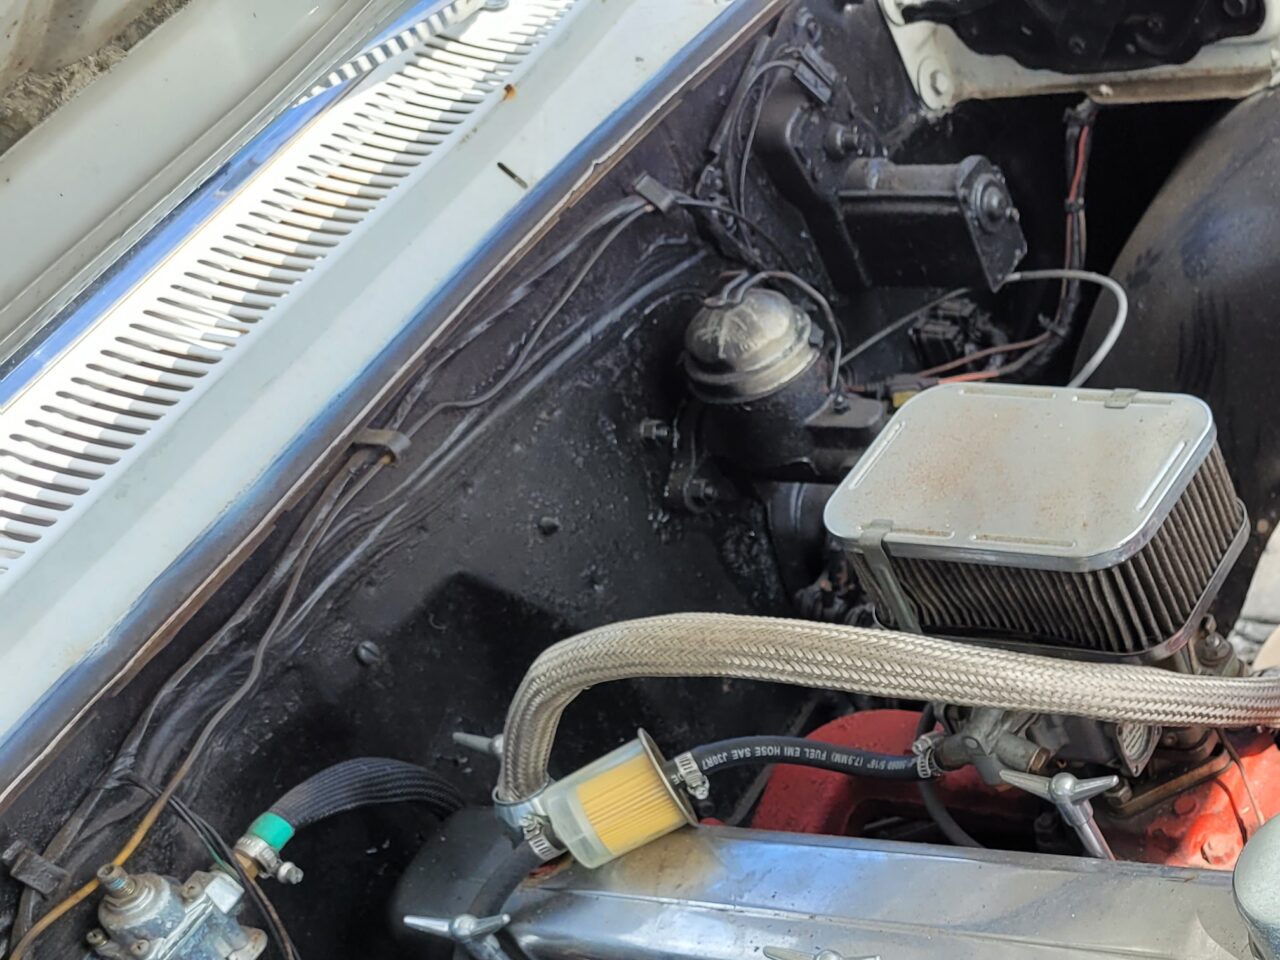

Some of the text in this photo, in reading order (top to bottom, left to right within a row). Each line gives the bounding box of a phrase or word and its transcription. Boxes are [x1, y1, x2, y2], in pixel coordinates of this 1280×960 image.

[731, 747, 751, 758] SAE
[755, 745, 780, 755] HOSE
[804, 748, 827, 760] FUEL
